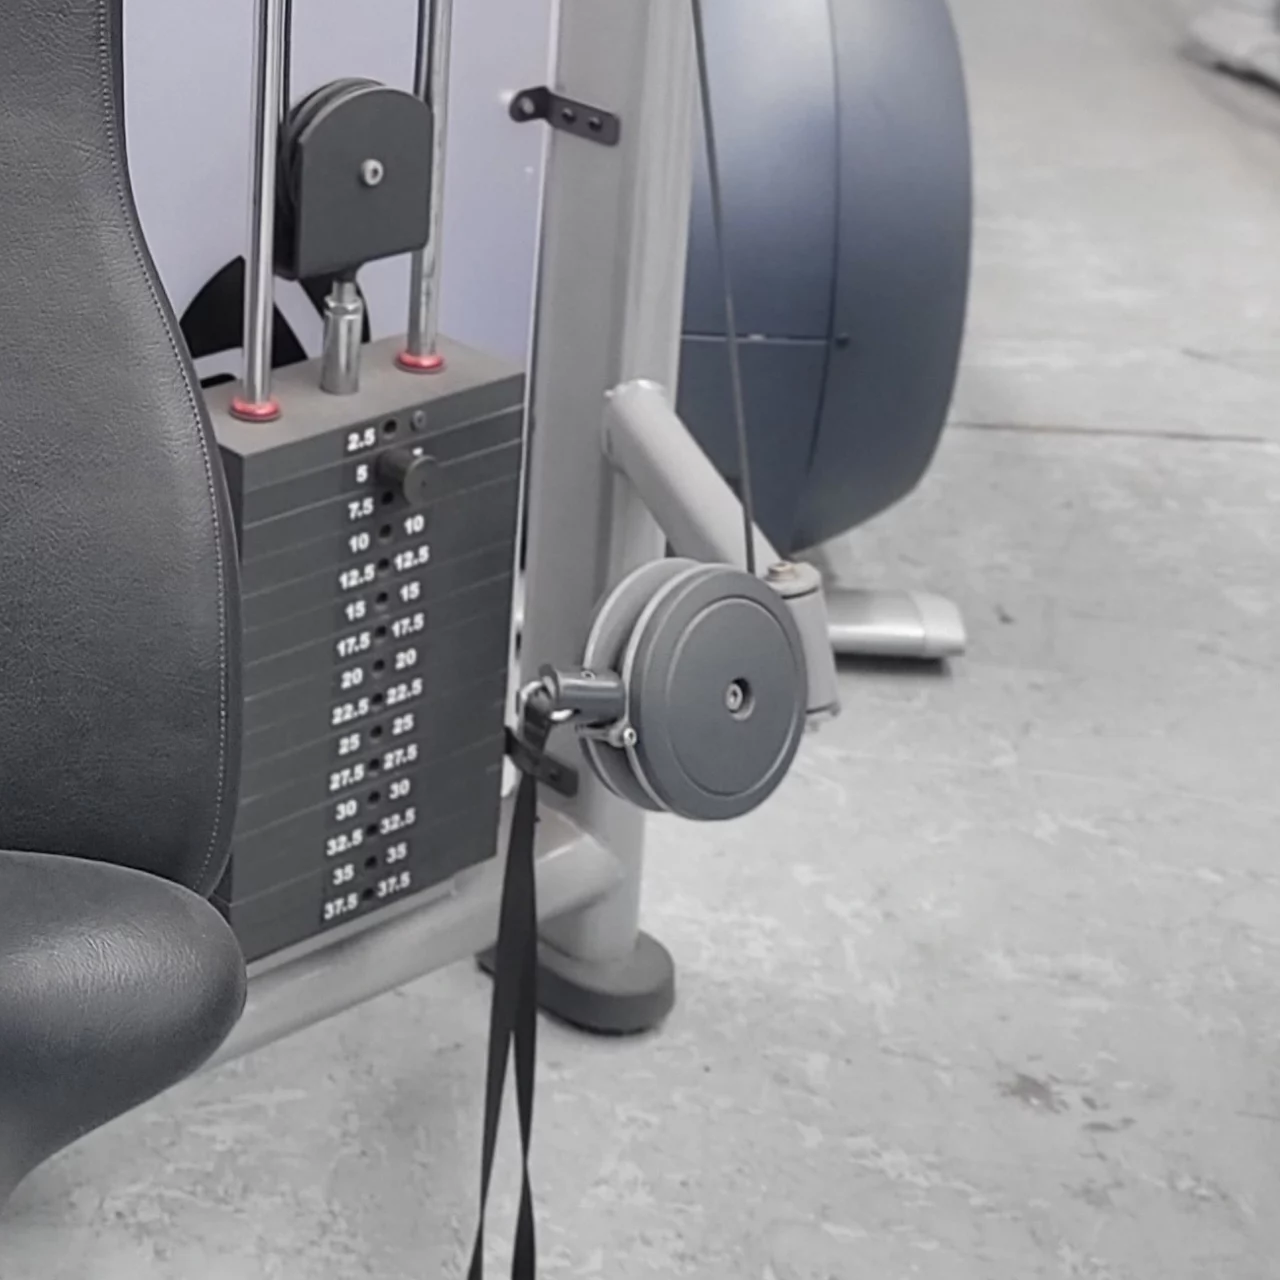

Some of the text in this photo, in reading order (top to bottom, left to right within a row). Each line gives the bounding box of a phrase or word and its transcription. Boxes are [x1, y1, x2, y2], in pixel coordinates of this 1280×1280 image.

[347, 427, 375, 451] 2.5
[356, 464, 368, 483] 5
[348, 497, 373, 519] 7.5
[404, 515, 424, 534] 10
[349, 532, 370, 552] 10
[394, 545, 429, 570] 12.5
[339, 563, 375, 589] 12.5
[400, 581, 420, 601] 15
[345, 600, 366, 620] 15
[392, 613, 424, 637] 17.5
[337, 631, 371, 657] 17.5
[395, 648, 417, 669] 20
[341, 667, 363, 689] 20
[386, 678, 422, 705] 22.5
[332, 698, 369, 725] 22.5
[392, 714, 414, 735] 25
[339, 733, 360, 755] 25
[383, 744, 417, 770] 27.5
[330, 763, 365, 791] 27.5
[390, 779, 410, 799] 30
[336, 799, 357, 820] 30
[380, 808, 416, 834] 32.5
[326, 829, 363, 856] 32.5
[386, 842, 407, 863] 35
[333, 864, 354, 885] 35
[377, 872, 410, 897] 37.5
[324, 893, 358, 919] 37.5
